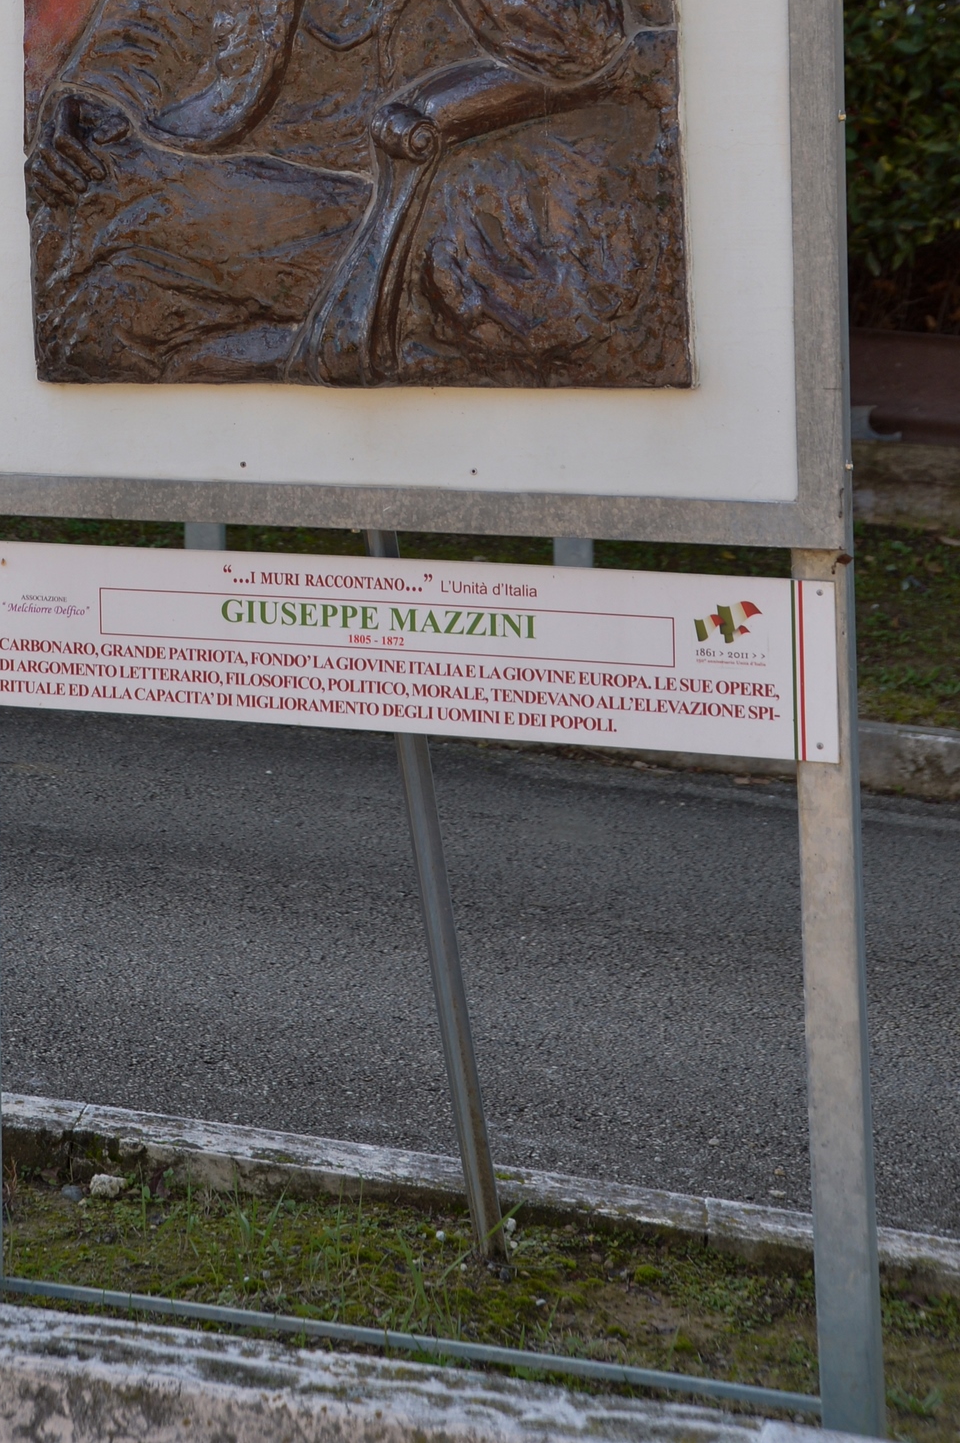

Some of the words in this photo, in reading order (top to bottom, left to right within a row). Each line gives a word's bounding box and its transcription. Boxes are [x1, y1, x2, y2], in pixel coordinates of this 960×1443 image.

[261, 572, 300, 586] MURI
[21, 594, 67, 603] ASSOCIAZIONE
[221, 599, 380, 630] GIUSEPPE
[389, 607, 537, 639] MAZZINI
[348, 634, 372, 645] 1805
[381, 636, 405, 646] 1872
[695, 648, 716, 657] 1861
[727, 651, 749, 659] 2011
[100, 643, 166, 659] GRANDE
[169, 647, 248, 666] PATRIOTA,
[313, 655, 335, 670] LA
[336, 656, 406, 674] GIOVINE
[409, 661, 463, 677] ITALIA
[465, 664, 476, 678] E
[479, 665, 501, 680] LA
[502, 666, 576, 685] GIOVINE
[579, 671, 652, 690] EUROPA.
[654, 676, 677, 691] LE
[679, 678, 713, 694] SUE
[715, 680, 780, 701] OPERE,
[0, 658, 14, 671] DI
[16, 660, 117, 678] ARGOMENTO
[119, 665, 224, 687] LETTERARIO,
[225, 671, 326, 693] FILOSOFICO,
[328, 678, 410, 698] POLITICO,
[412, 683, 489, 704] MORALE,
[490, 687, 595, 708] TENDEVANO
[747, 705, 781, 721] SPI-
[0, 679, 66, 696] RITUALE
[68, 683, 89, 697] ED
[90, 685, 133, 700] ALLA
[216, 692, 234, 707] DI
[236, 694, 380, 716] MIGLIORAMENTO
[382, 703, 434, 720] DEGLI
[437, 707, 500, 725] UOMINI
[504, 711, 515, 725] E
[518, 712, 547, 728] DEI
[550, 714, 617, 733] POPOLI.
